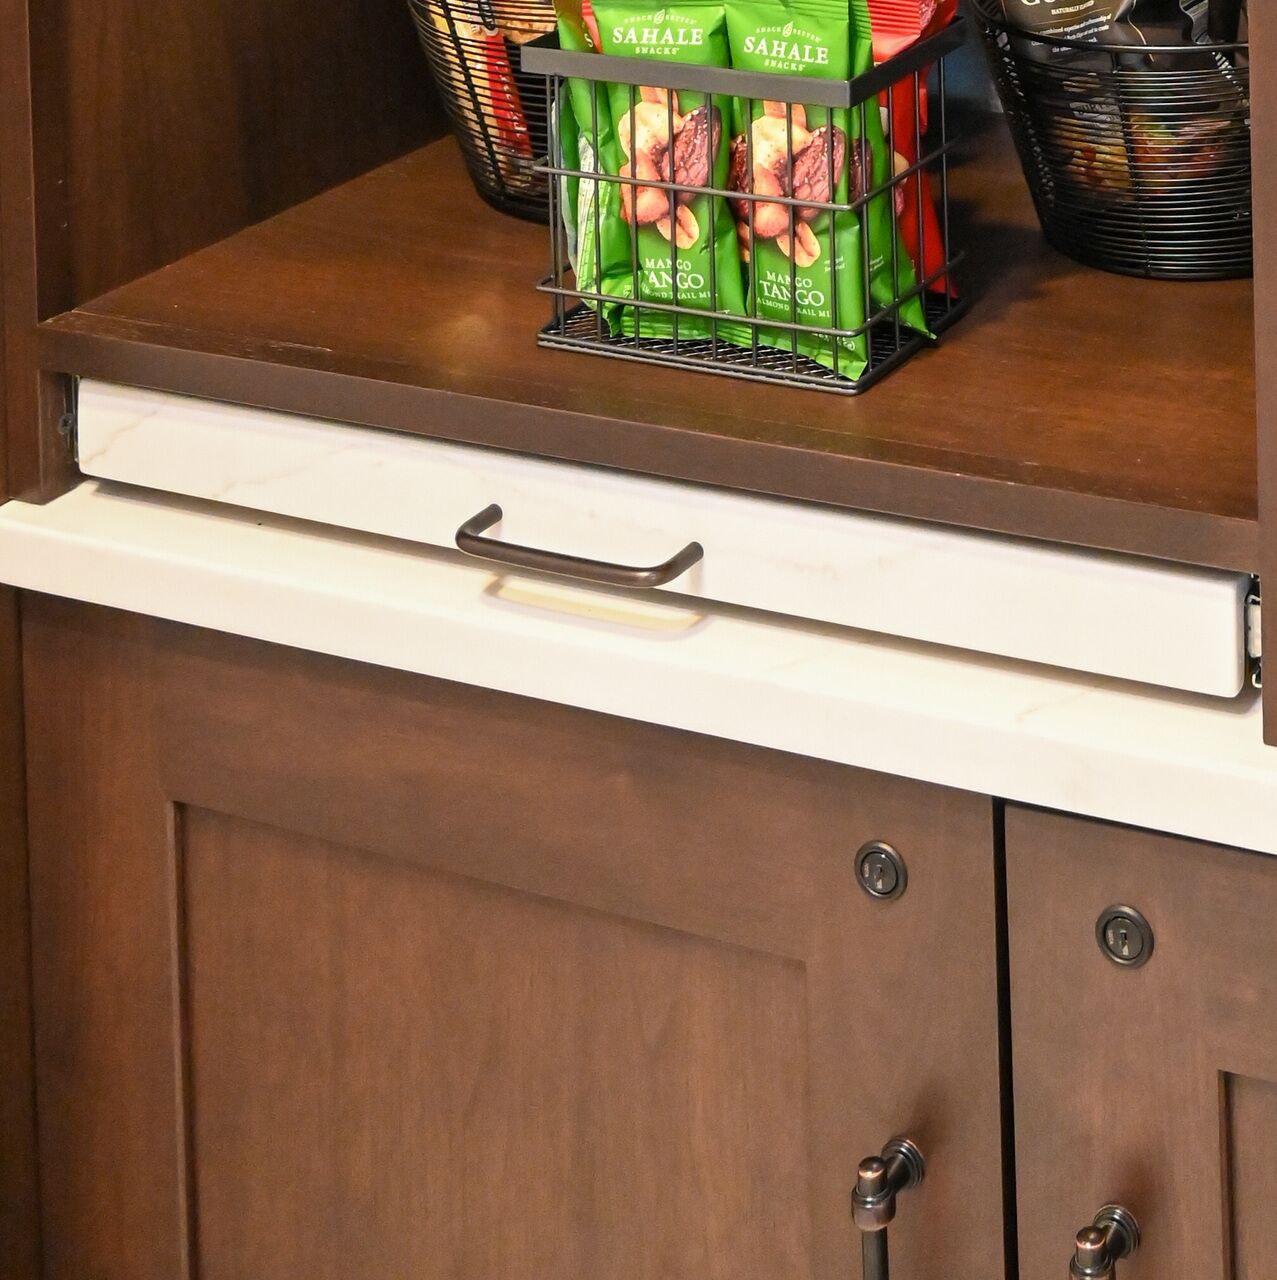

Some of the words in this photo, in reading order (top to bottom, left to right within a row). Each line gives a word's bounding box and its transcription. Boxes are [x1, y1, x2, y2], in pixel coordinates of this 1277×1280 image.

[612, 26, 704, 46] SAHALE
[635, 46, 680, 56] SNACKS
[743, 35, 830, 65] SAHALE
[764, 58, 806, 72] SNACKS
[645, 257, 692, 272] MANGO
[766, 270, 812, 288] MANGO
[759, 279, 825, 307] TANGO
